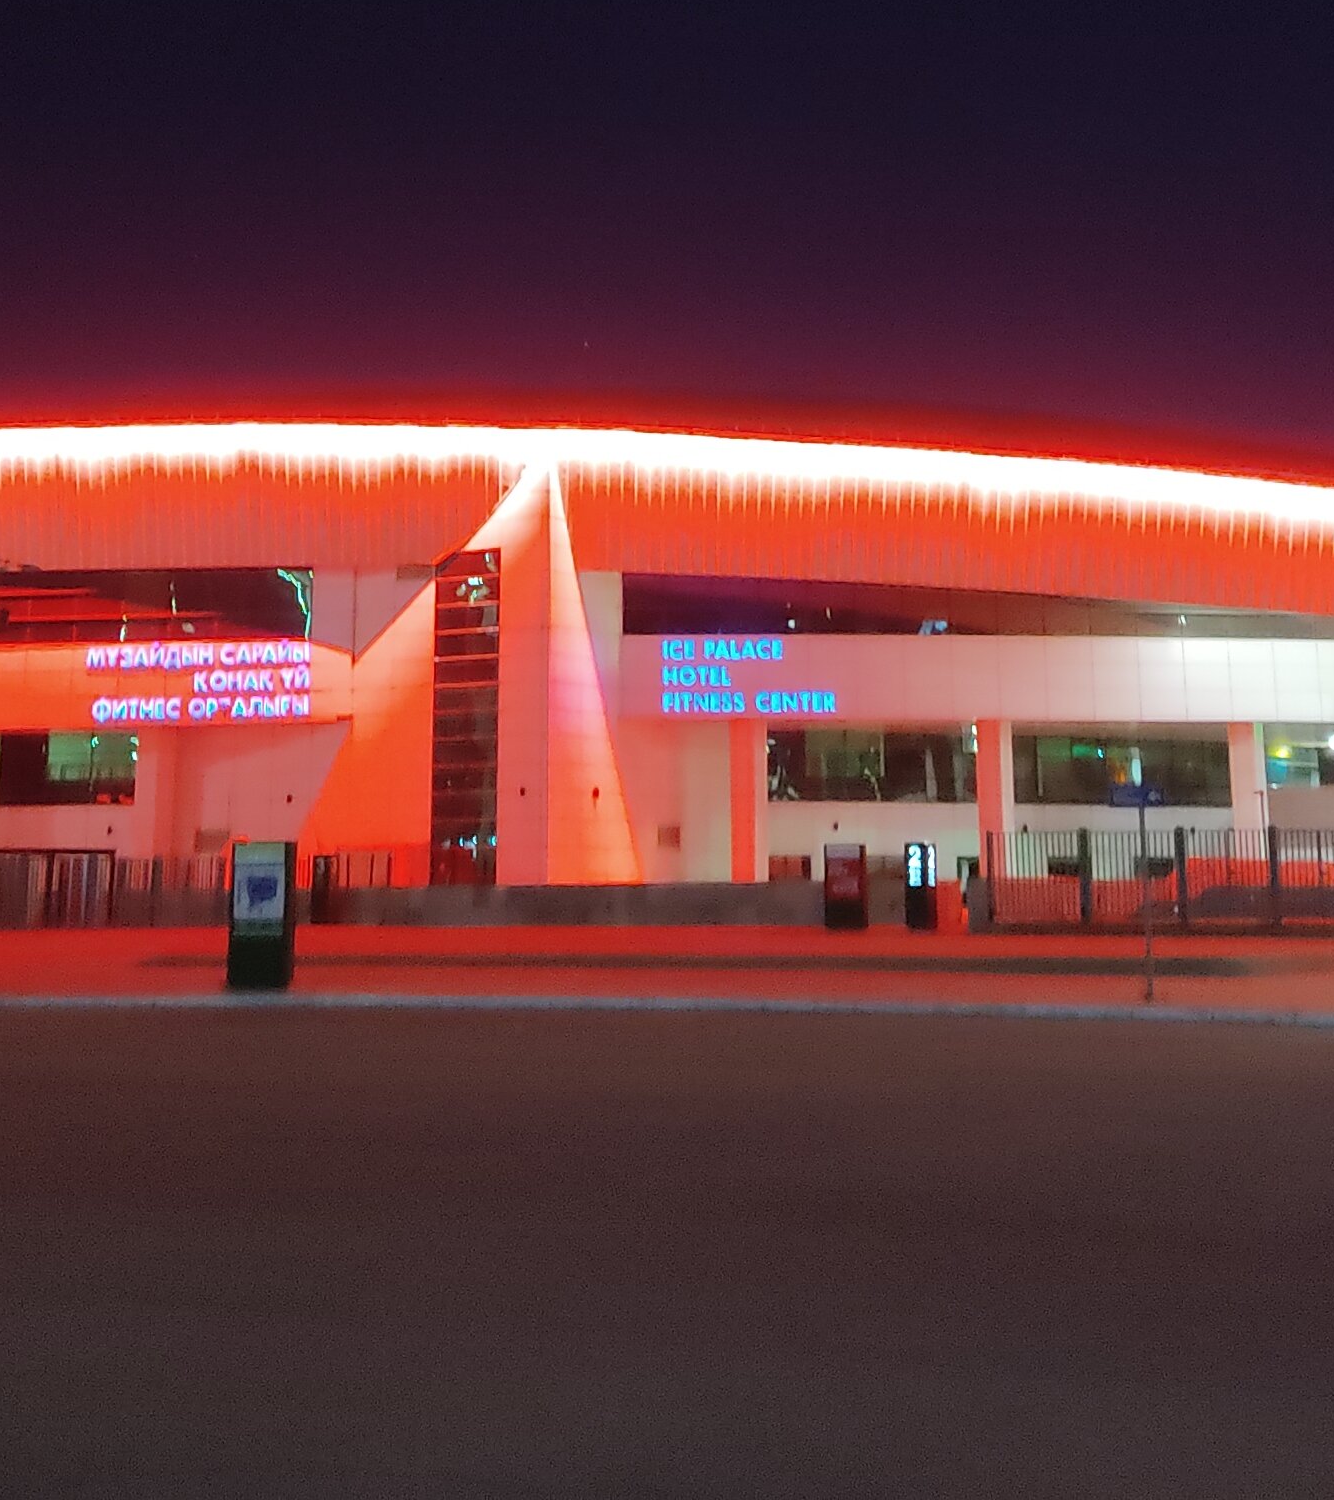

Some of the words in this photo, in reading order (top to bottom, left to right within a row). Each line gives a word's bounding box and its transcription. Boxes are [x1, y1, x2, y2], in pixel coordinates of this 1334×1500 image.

[220, 639, 310, 666] САРАЙЫ
[662, 639, 695, 661] ICE
[703, 638, 783, 661] PALACE
[662, 665, 732, 687] HOTEL
[92, 697, 182, 723] ФИТНЕС
[662, 691, 746, 713] FITNESS
[755, 691, 837, 713] CENTER
